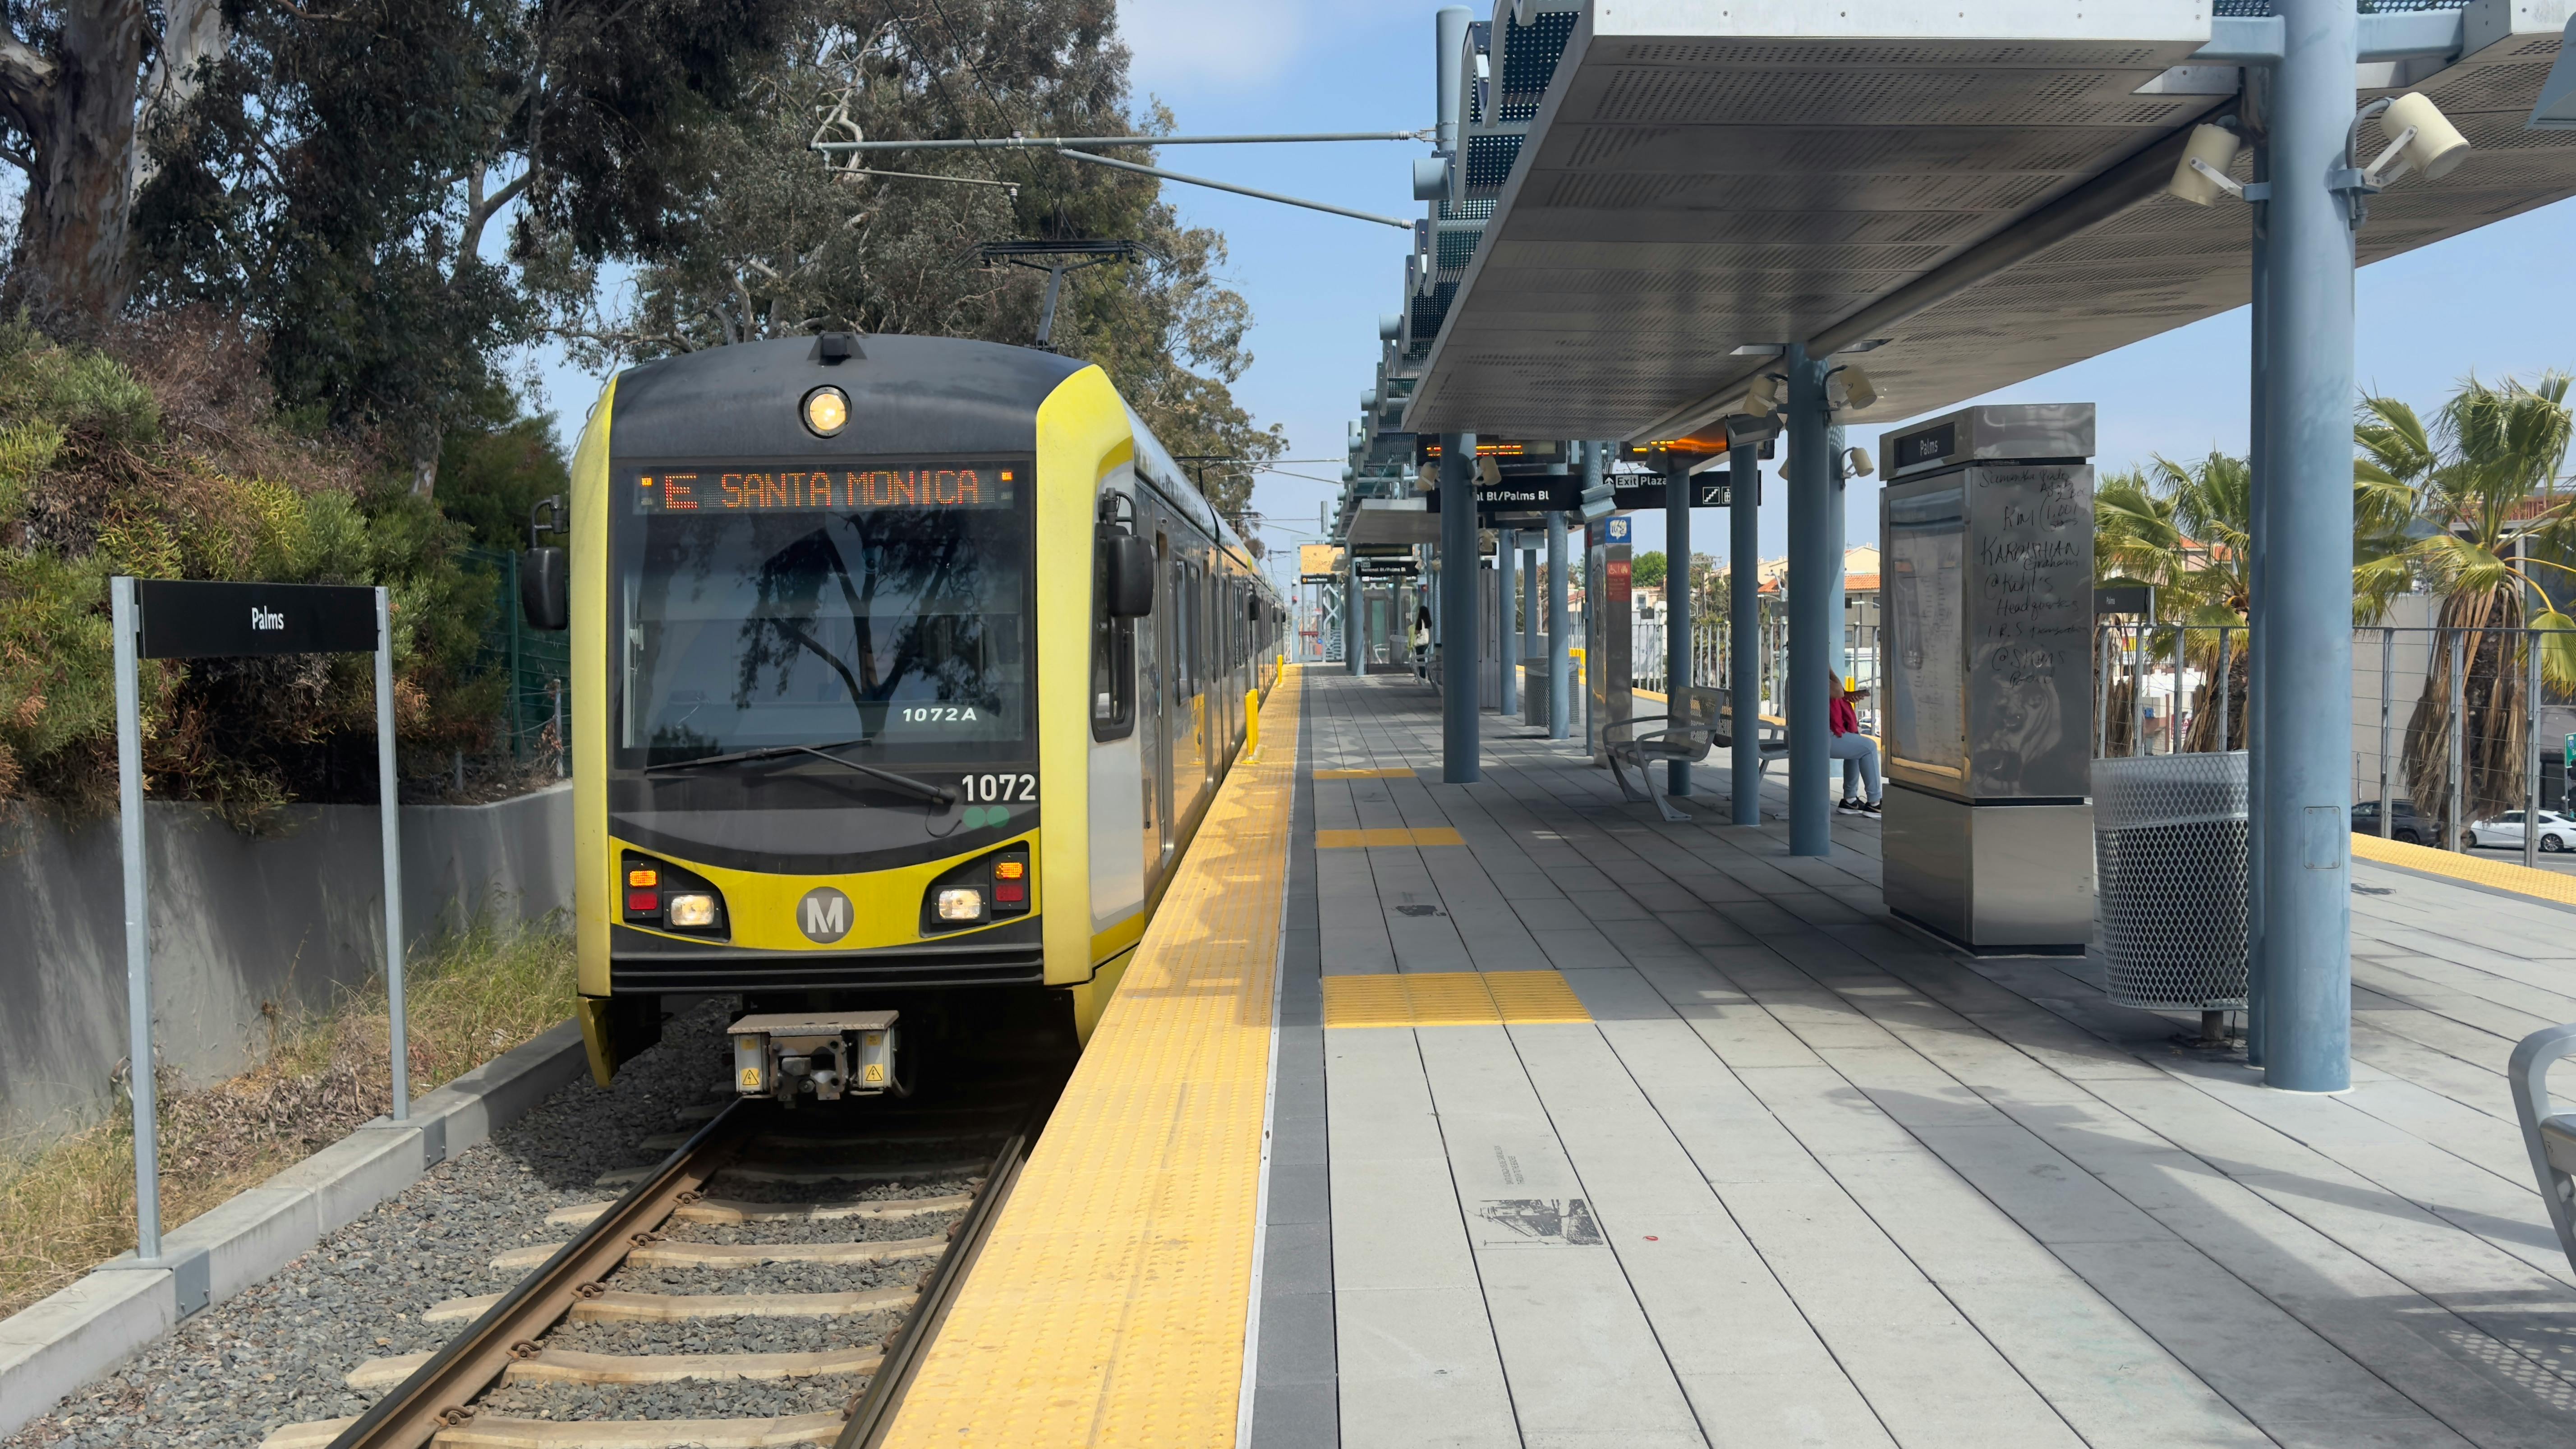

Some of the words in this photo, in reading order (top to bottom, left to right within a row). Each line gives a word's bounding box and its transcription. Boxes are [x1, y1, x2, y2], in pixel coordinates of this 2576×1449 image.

[1920, 439, 1938, 455] Palms
[664, 474, 699, 509] E
[721, 472, 831, 508] SANTA
[847, 469, 978, 506] MONICA
[1618, 477, 1638, 486] Exit
[1640, 476, 1666, 486] Plaza
[1487, 491, 1535, 501] Bl/Palms
[1538, 491, 1549, 501] Bl
[252, 605, 284, 630] Palms
[903, 707, 977, 722] 1072A
[962, 774, 1036, 801] 1072
[807, 897, 844, 933] M
